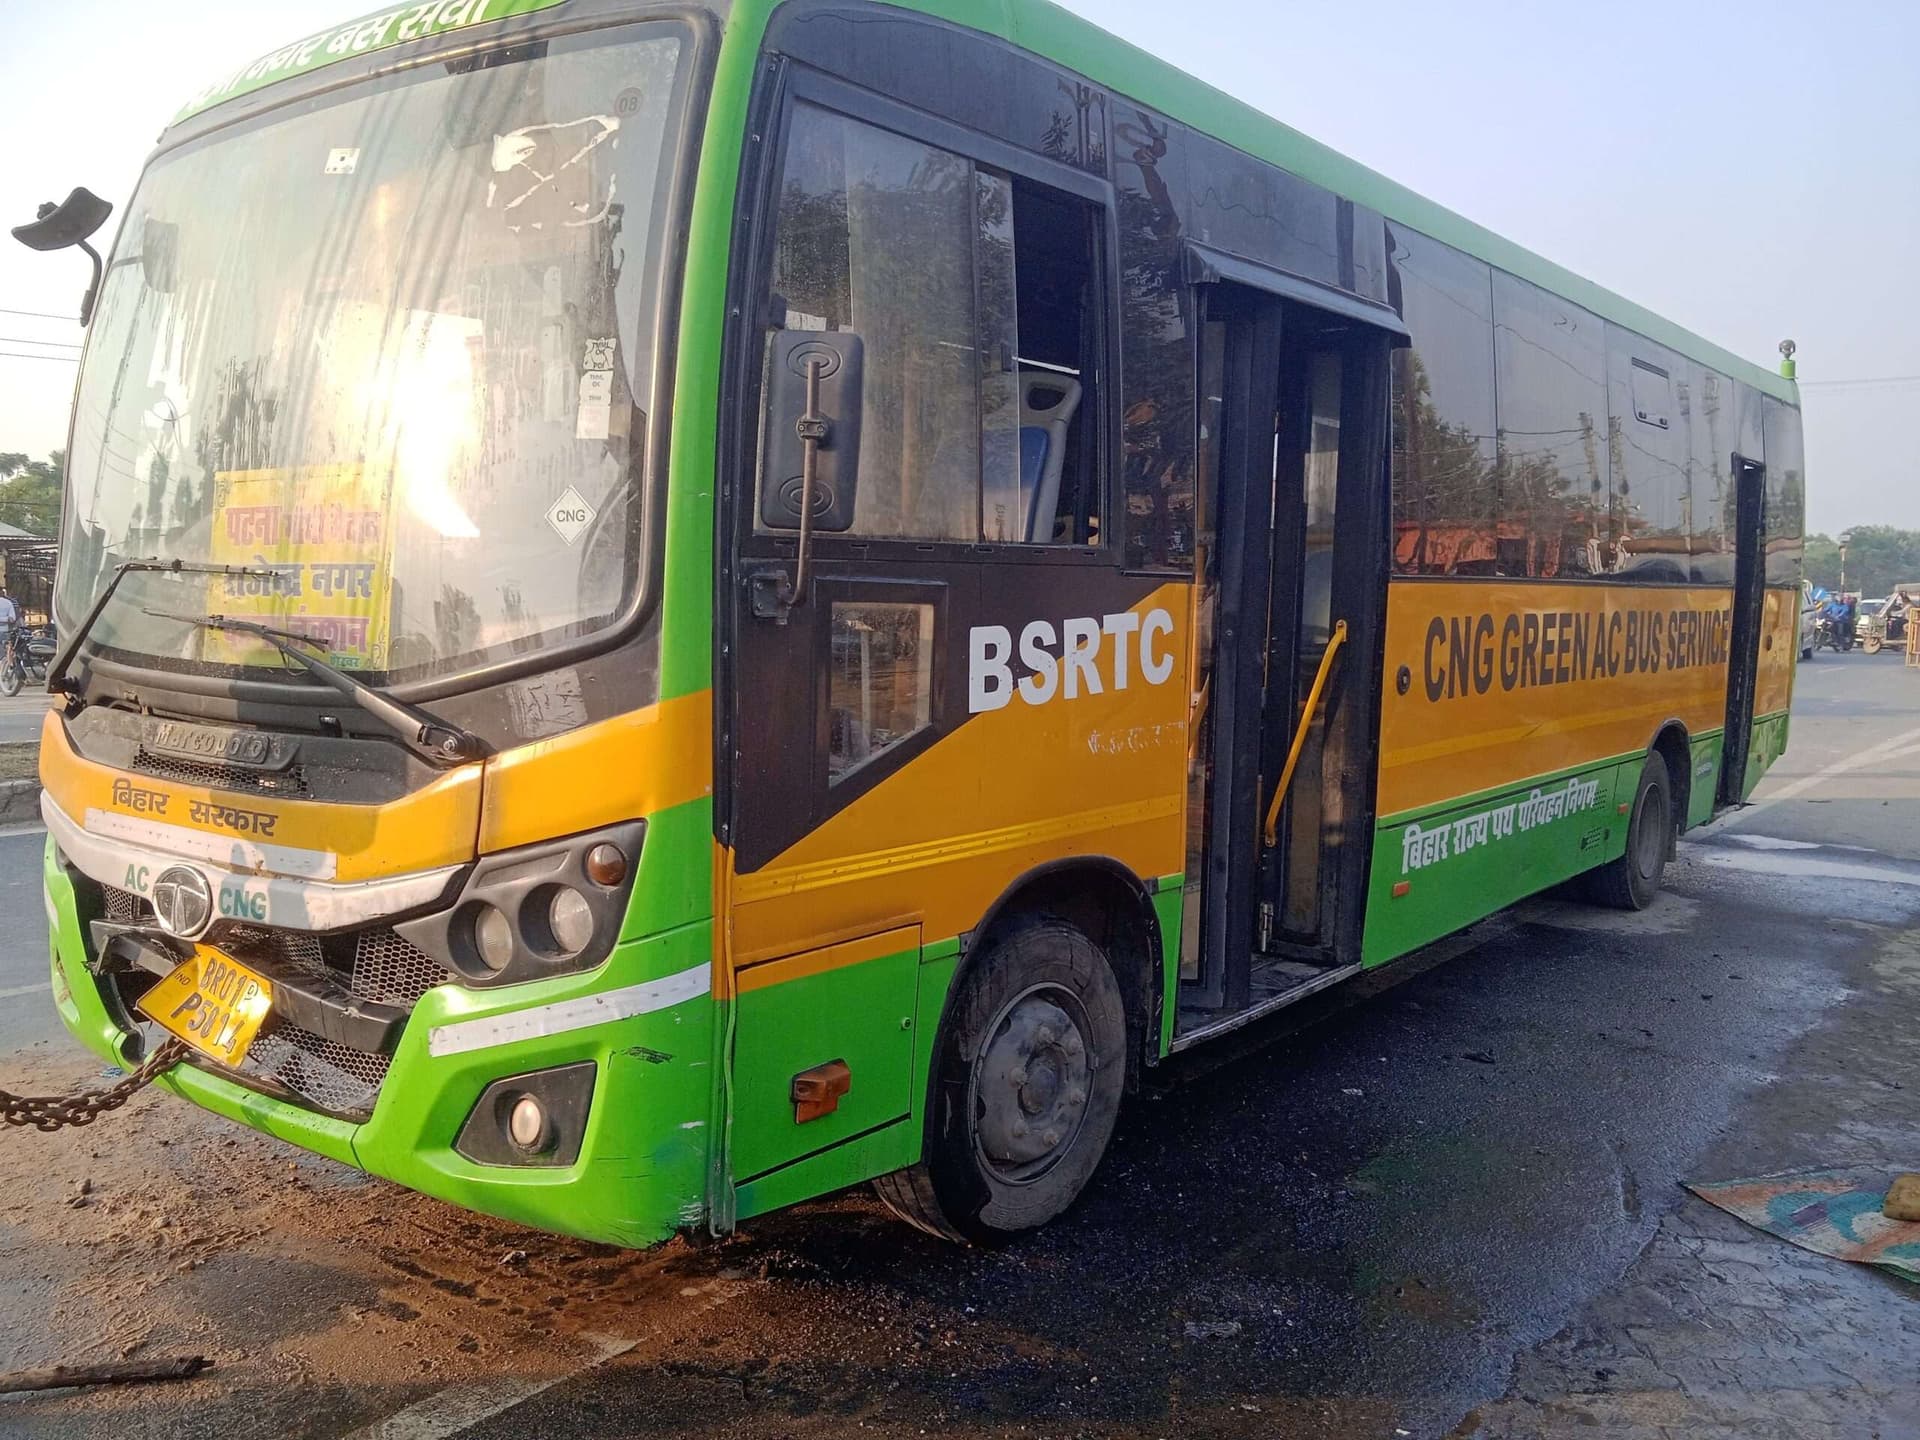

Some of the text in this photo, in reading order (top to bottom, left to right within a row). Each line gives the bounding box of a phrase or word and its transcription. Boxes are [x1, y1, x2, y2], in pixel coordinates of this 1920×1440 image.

[327, 14, 394, 54] बस
[225, 506, 281, 546] पटना
[556, 509, 586, 522] CNG
[310, 563, 376, 598] नगर
[968, 608, 1175, 714] BSRTC
[1424, 609, 1730, 703] CNG GREEN AC BUS SERVICE
[112, 778, 278, 837] बिहार सरकार
[1401, 822, 1451, 875] बिहार
[1452, 810, 1491, 855] राज्य
[1517, 788, 1563, 833] परिवहन
[1563, 777, 1600, 818] निगम
[124, 863, 266, 920] AC CNG
[174, 972, 191, 986] IND
